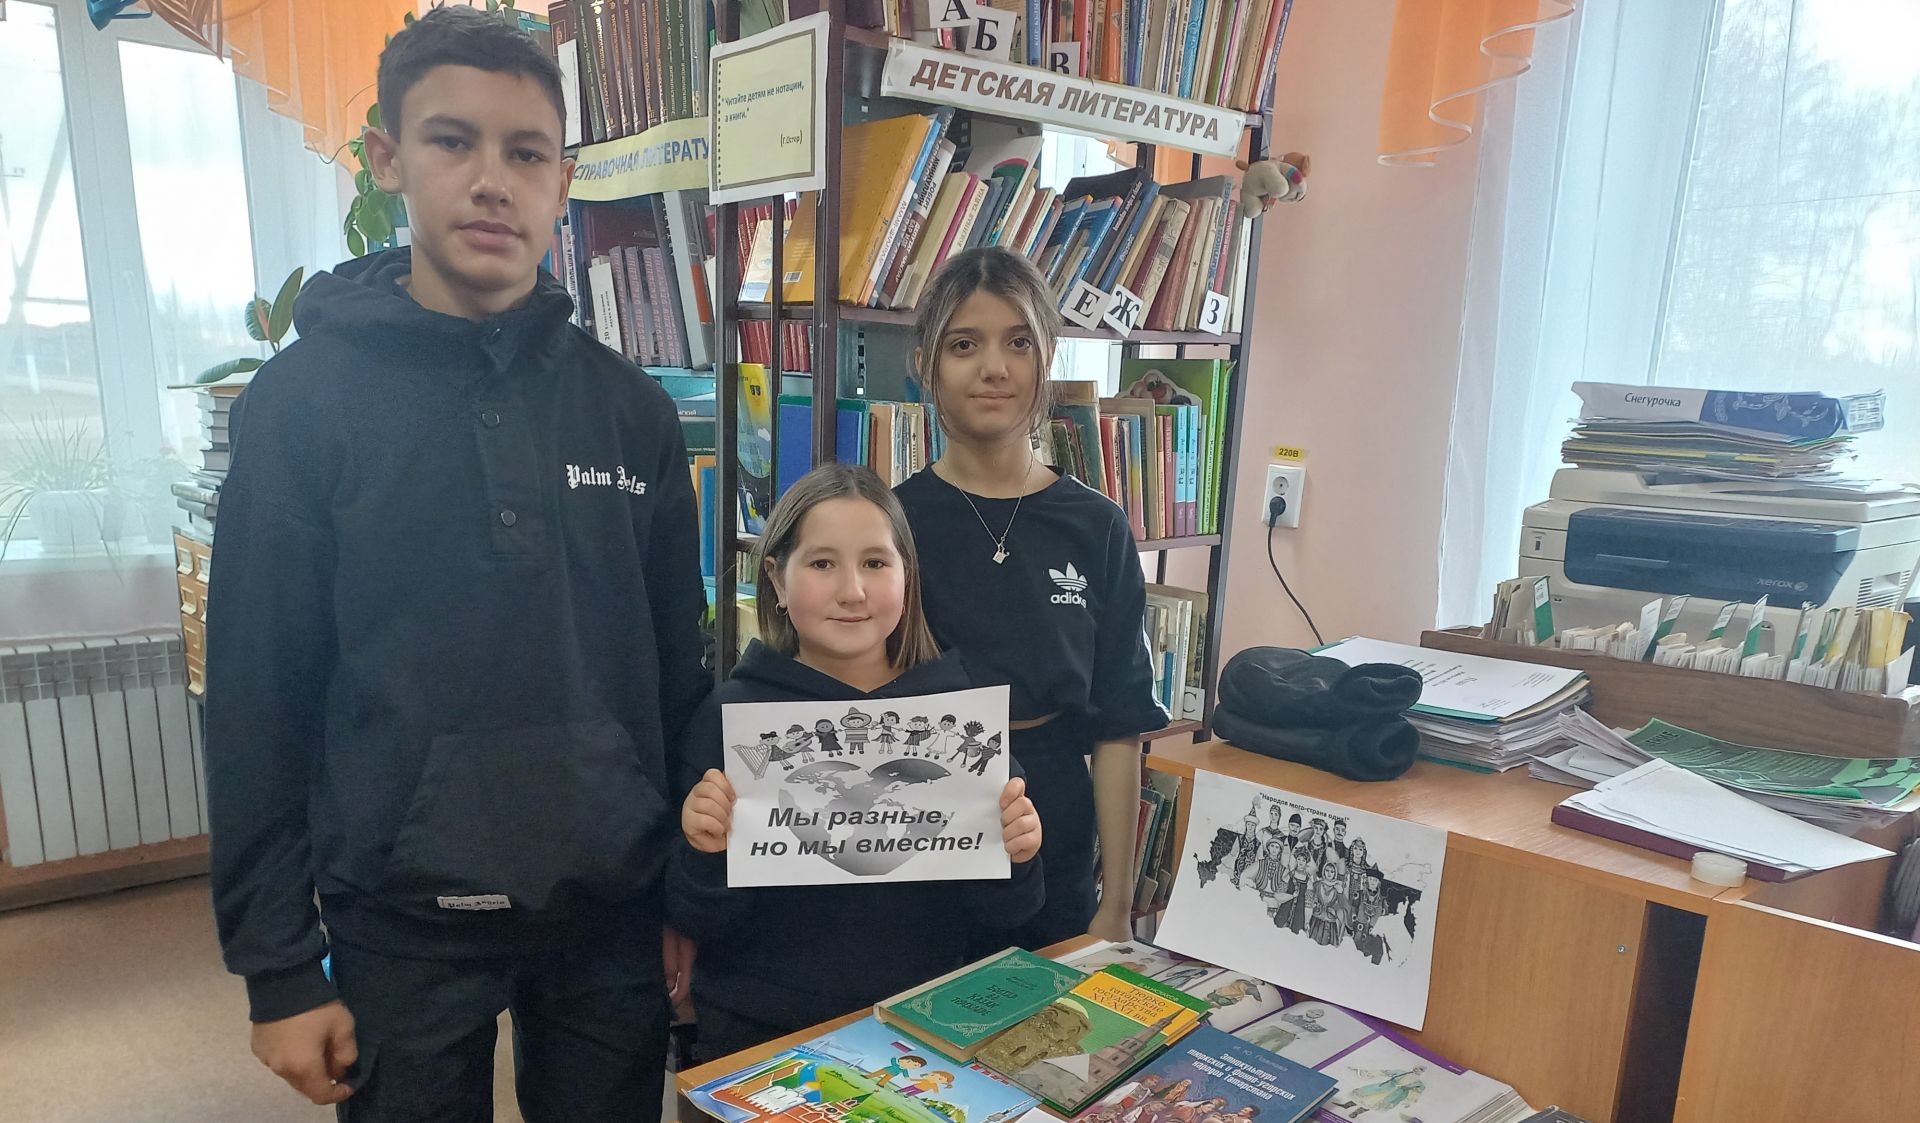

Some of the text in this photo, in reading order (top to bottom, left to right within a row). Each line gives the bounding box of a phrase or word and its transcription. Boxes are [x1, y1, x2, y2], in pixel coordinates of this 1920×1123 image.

[941, 0, 971, 21] А
[972, 17, 999, 51] Б
[747, 90, 766, 103] детям
[767, 88, 775, 96] не
[776, 81, 804, 95] нотации,
[910, 58, 1220, 141] ДЕТСКАЯ ЛИТЕРАТУРА
[573, 150, 639, 180] СПРАВОЧНАЯ
[917, 157, 941, 206] МИННУЛЛИН
[923, 182, 937, 211] РОБЕРТ
[971, 187, 986, 213] ТАЙНА
[907, 223, 921, 254] ДЕПУТАТ
[1071, 287, 1100, 318] Е
[1108, 290, 1140, 328] Ж
[1207, 298, 1220, 325] З
[1624, 392, 1681, 407] Снегурочка
[1279, 448, 1299, 458] 220В
[566, 464, 612, 489] Palm
[1756, 578, 1794, 589] xerox
[1183, 692, 1197, 713] С
[767, 807, 949, 831] Мы разные,
[750, 832, 985, 856] но мы вместе!
[1092, 986, 1158, 1018] государства
[1109, 987, 1164, 1013] татарские
[1129, 988, 1168, 1007] Тюрко-
[1187, 1048, 1226, 1069] тюркских
[1231, 1068, 1296, 1101] финно-угорских
[1192, 1060, 1273, 1100] народов Татарстана
[1220, 1053, 1277, 1082] Этнокультура
